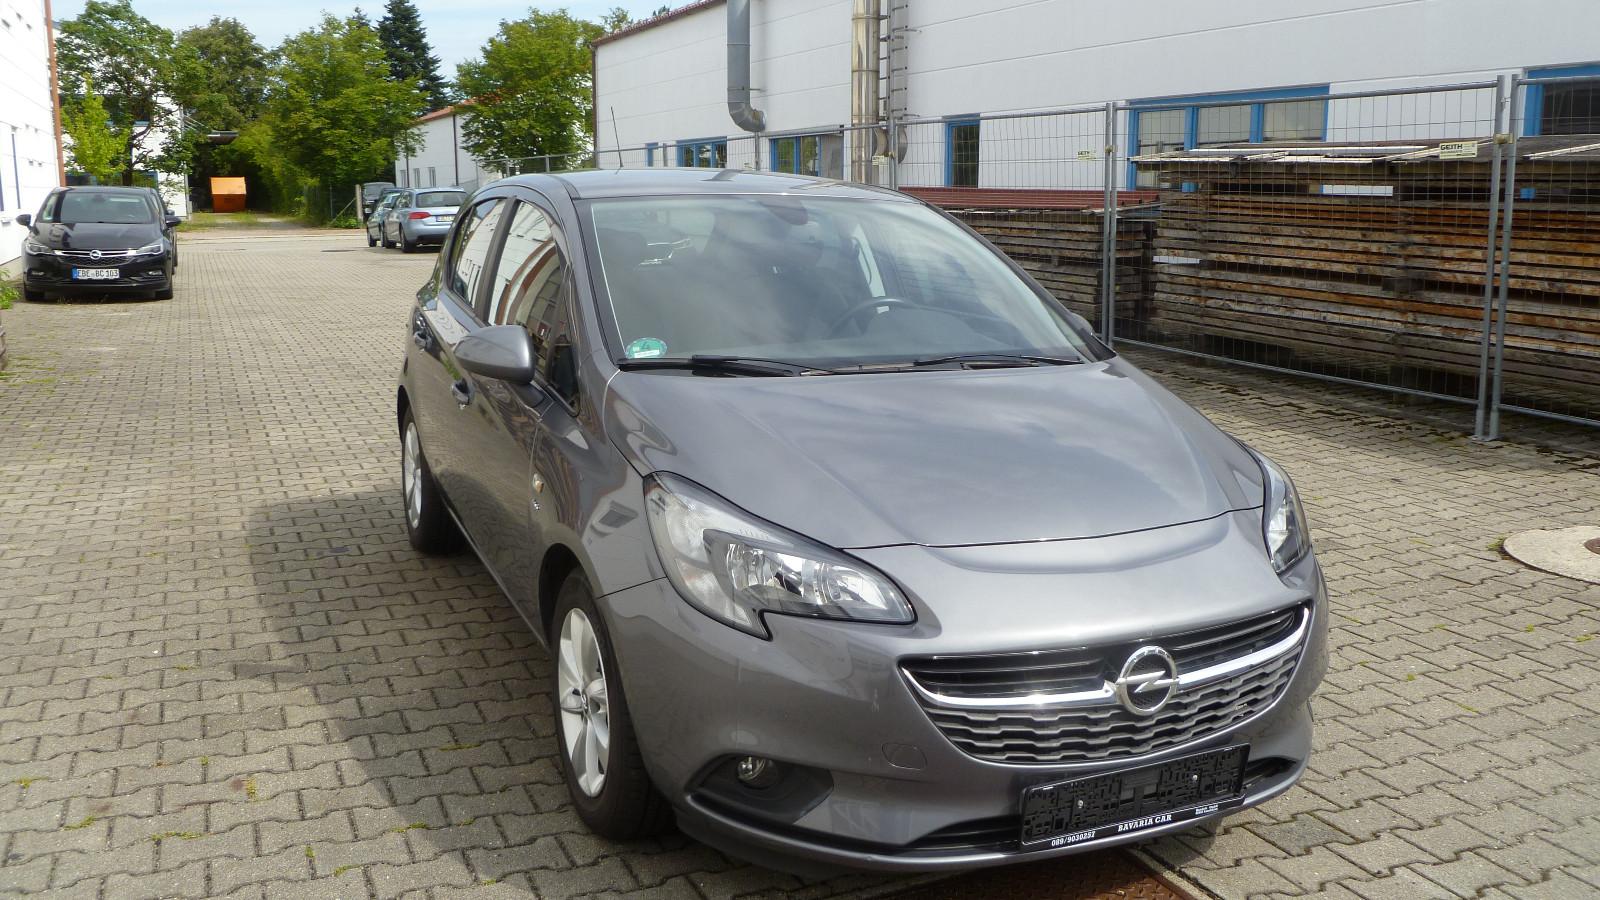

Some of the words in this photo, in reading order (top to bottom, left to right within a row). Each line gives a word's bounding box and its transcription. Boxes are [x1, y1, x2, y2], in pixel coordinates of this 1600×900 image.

[78, 269, 91, 278] EBE
[1118, 818, 1153, 832] BAVARIA
[1155, 814, 1172, 823] CAR
